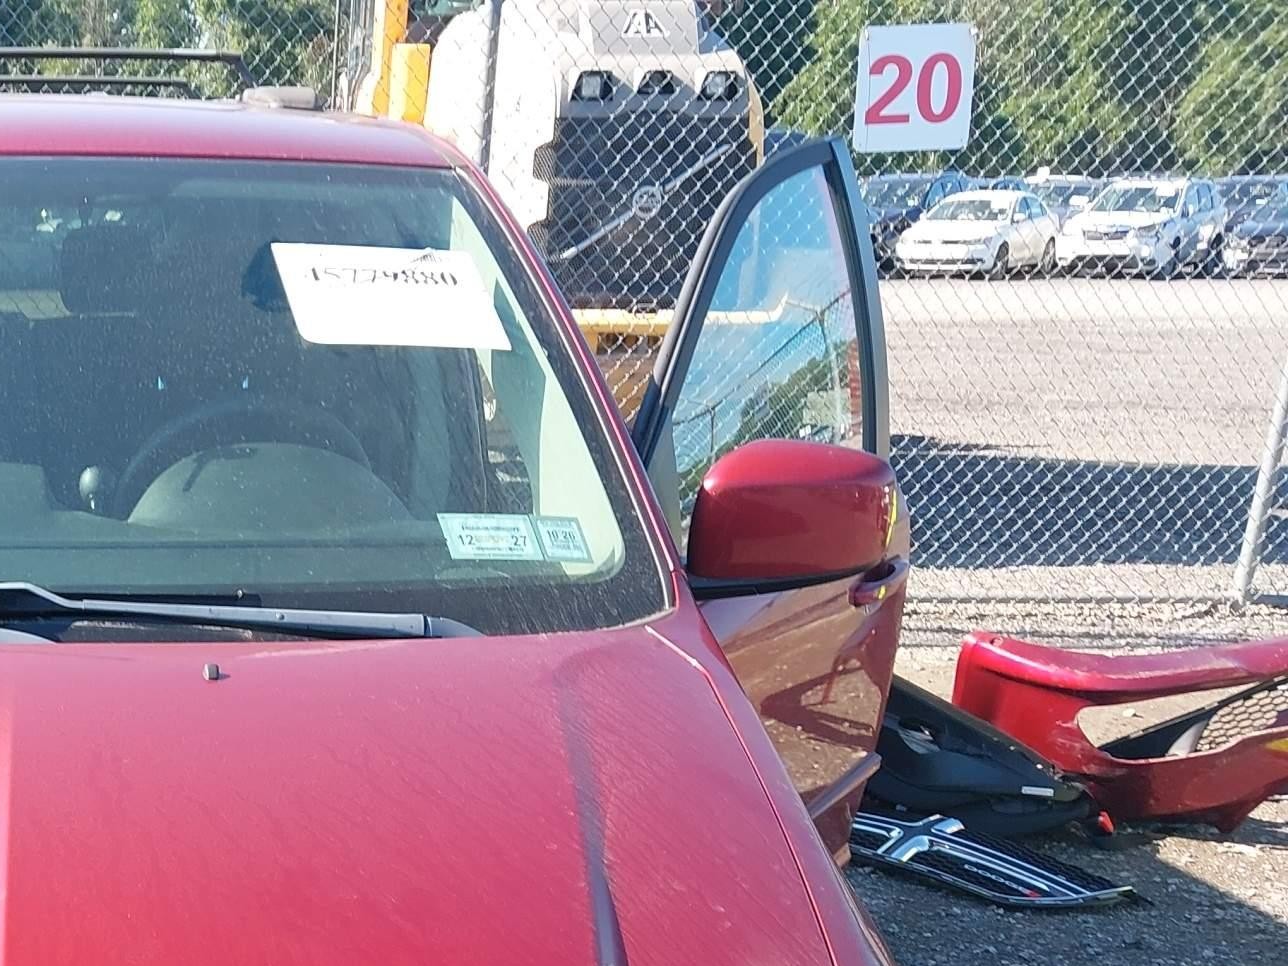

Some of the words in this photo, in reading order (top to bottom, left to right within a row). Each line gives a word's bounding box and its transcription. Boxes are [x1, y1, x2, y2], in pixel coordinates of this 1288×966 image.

[864, 52, 962, 125] 20
[458, 534, 475, 547] 12
[511, 535, 527, 547] 27
